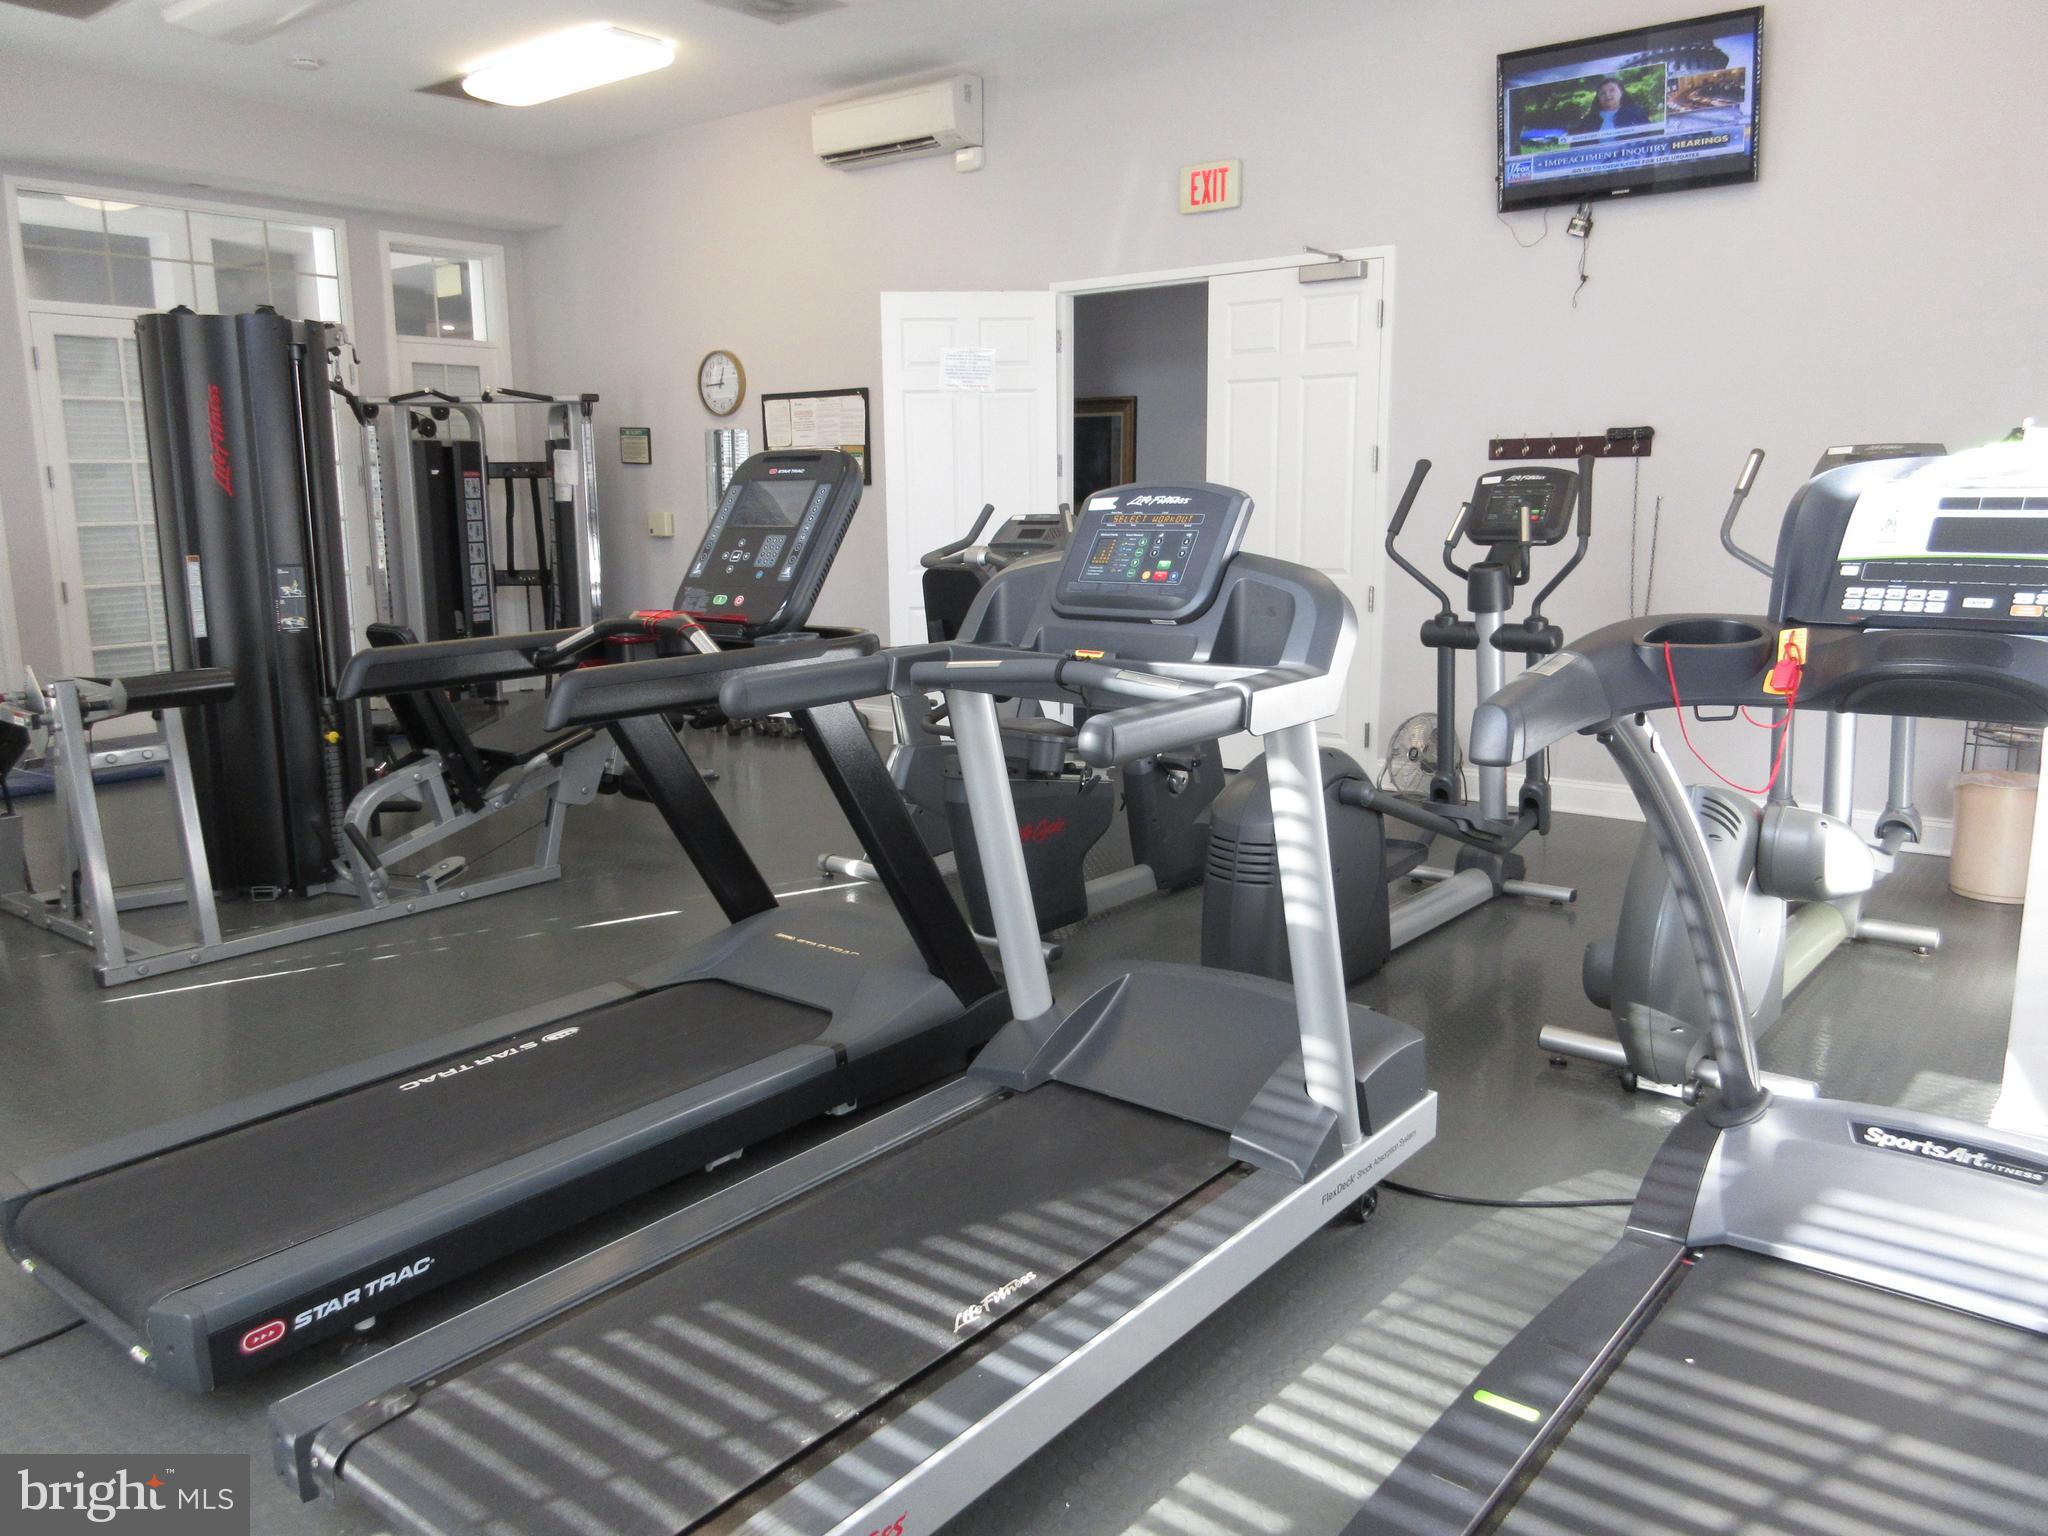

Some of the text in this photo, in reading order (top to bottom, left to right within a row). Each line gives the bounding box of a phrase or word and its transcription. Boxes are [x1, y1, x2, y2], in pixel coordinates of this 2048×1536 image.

[1621, 143, 1668, 157] INQUIRY
[1672, 134, 1729, 150] HEARINGS
[1190, 168, 1229, 206] EXIT
[1113, 515, 1194, 523] SELECT WORKOUT
[399, 1041, 538, 1092] STAR TRAC
[1863, 1127, 2043, 1181] SportsArt FITNESS
[293, 1256, 432, 1331] STAR TRAC
